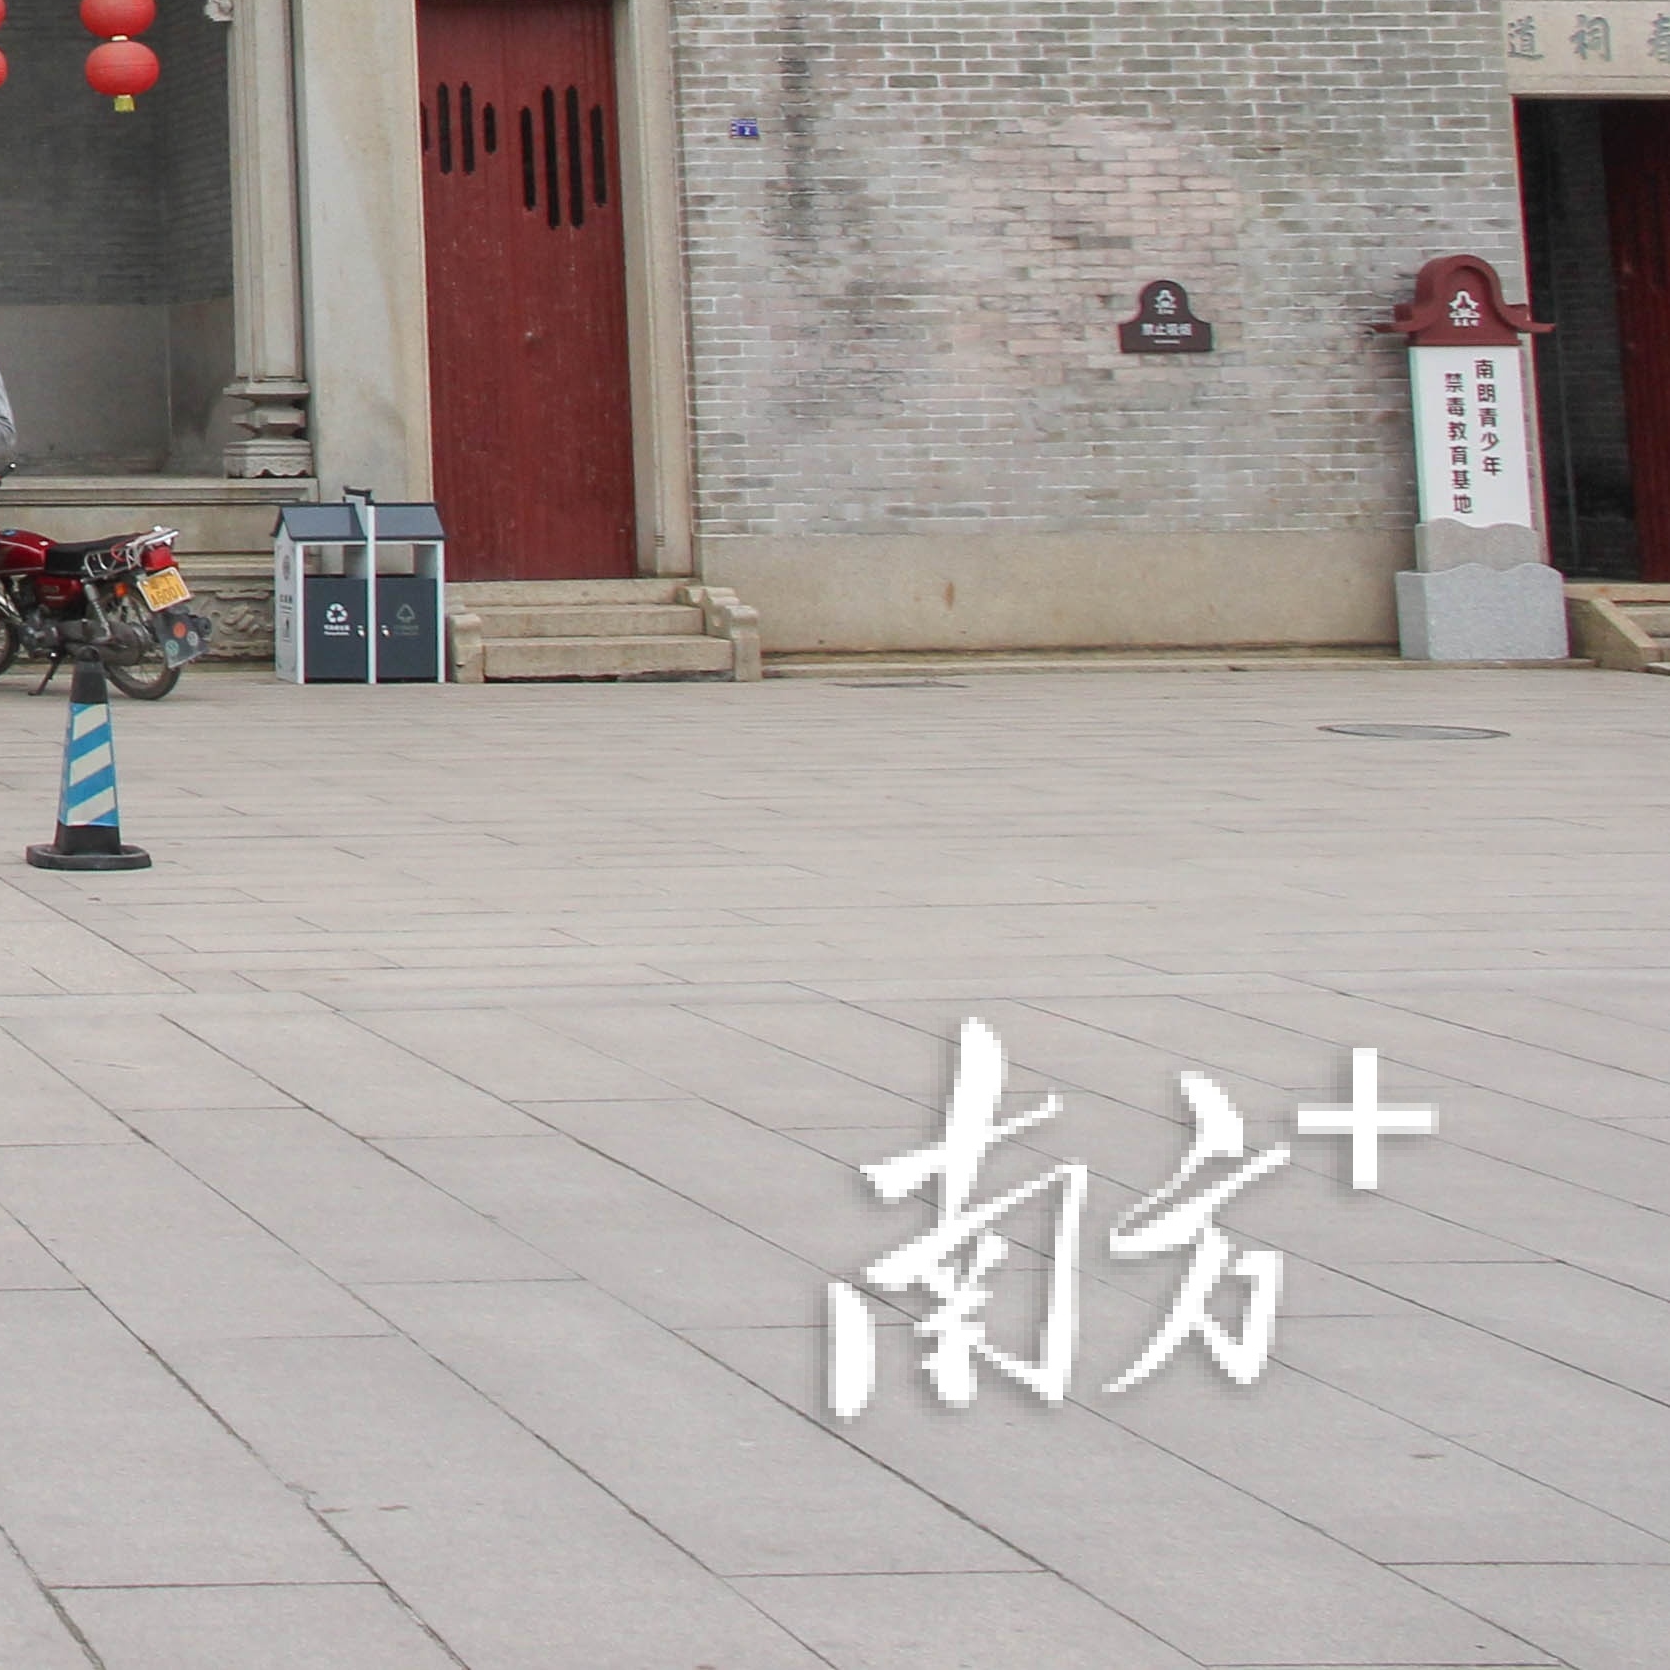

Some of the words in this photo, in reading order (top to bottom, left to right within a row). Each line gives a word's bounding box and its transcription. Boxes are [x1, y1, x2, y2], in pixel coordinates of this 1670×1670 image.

[1444, 372, 1473, 514] 禁毒教育基地
[1473, 358, 1503, 477] 南朗青少年
